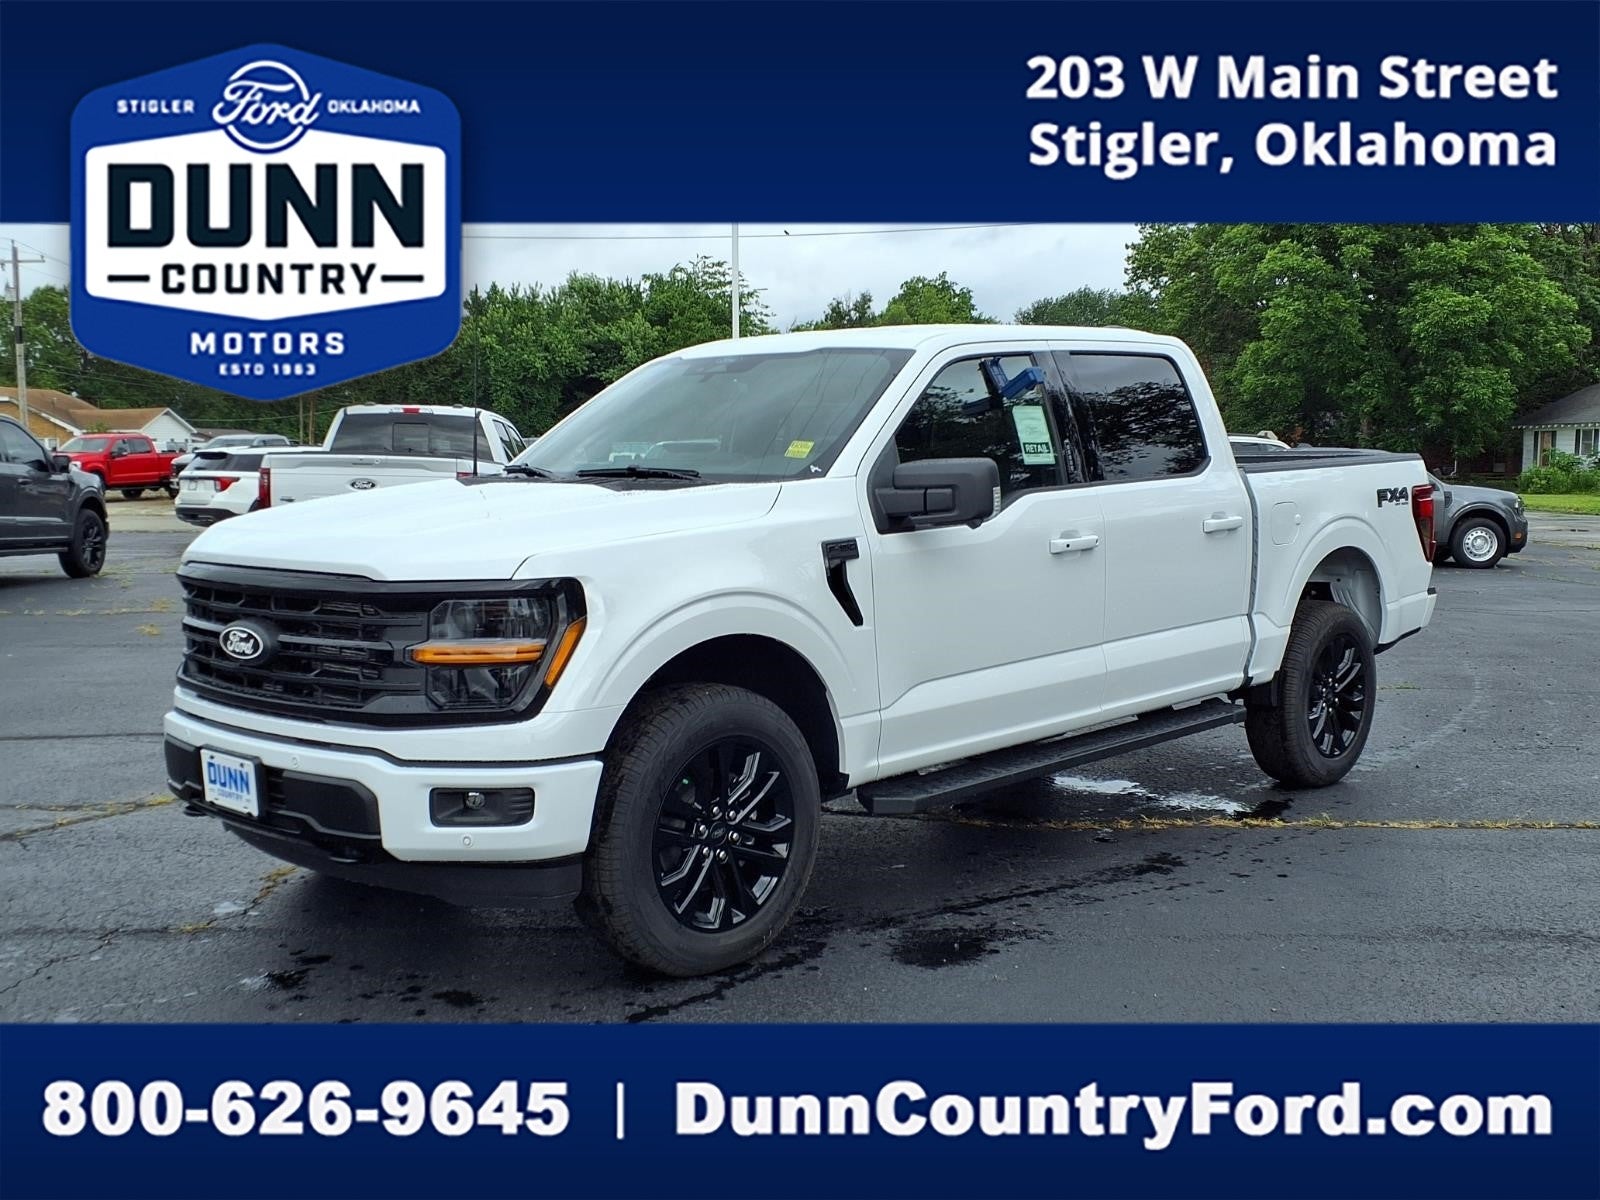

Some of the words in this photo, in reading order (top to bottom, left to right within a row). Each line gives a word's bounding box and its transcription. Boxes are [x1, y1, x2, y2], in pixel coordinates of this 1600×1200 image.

[1024, 443, 1050, 453] RETAIL
[1377, 487, 1409, 508] FX4
[227, 630, 255, 655] Ford
[207, 761, 251, 796] DUNN
